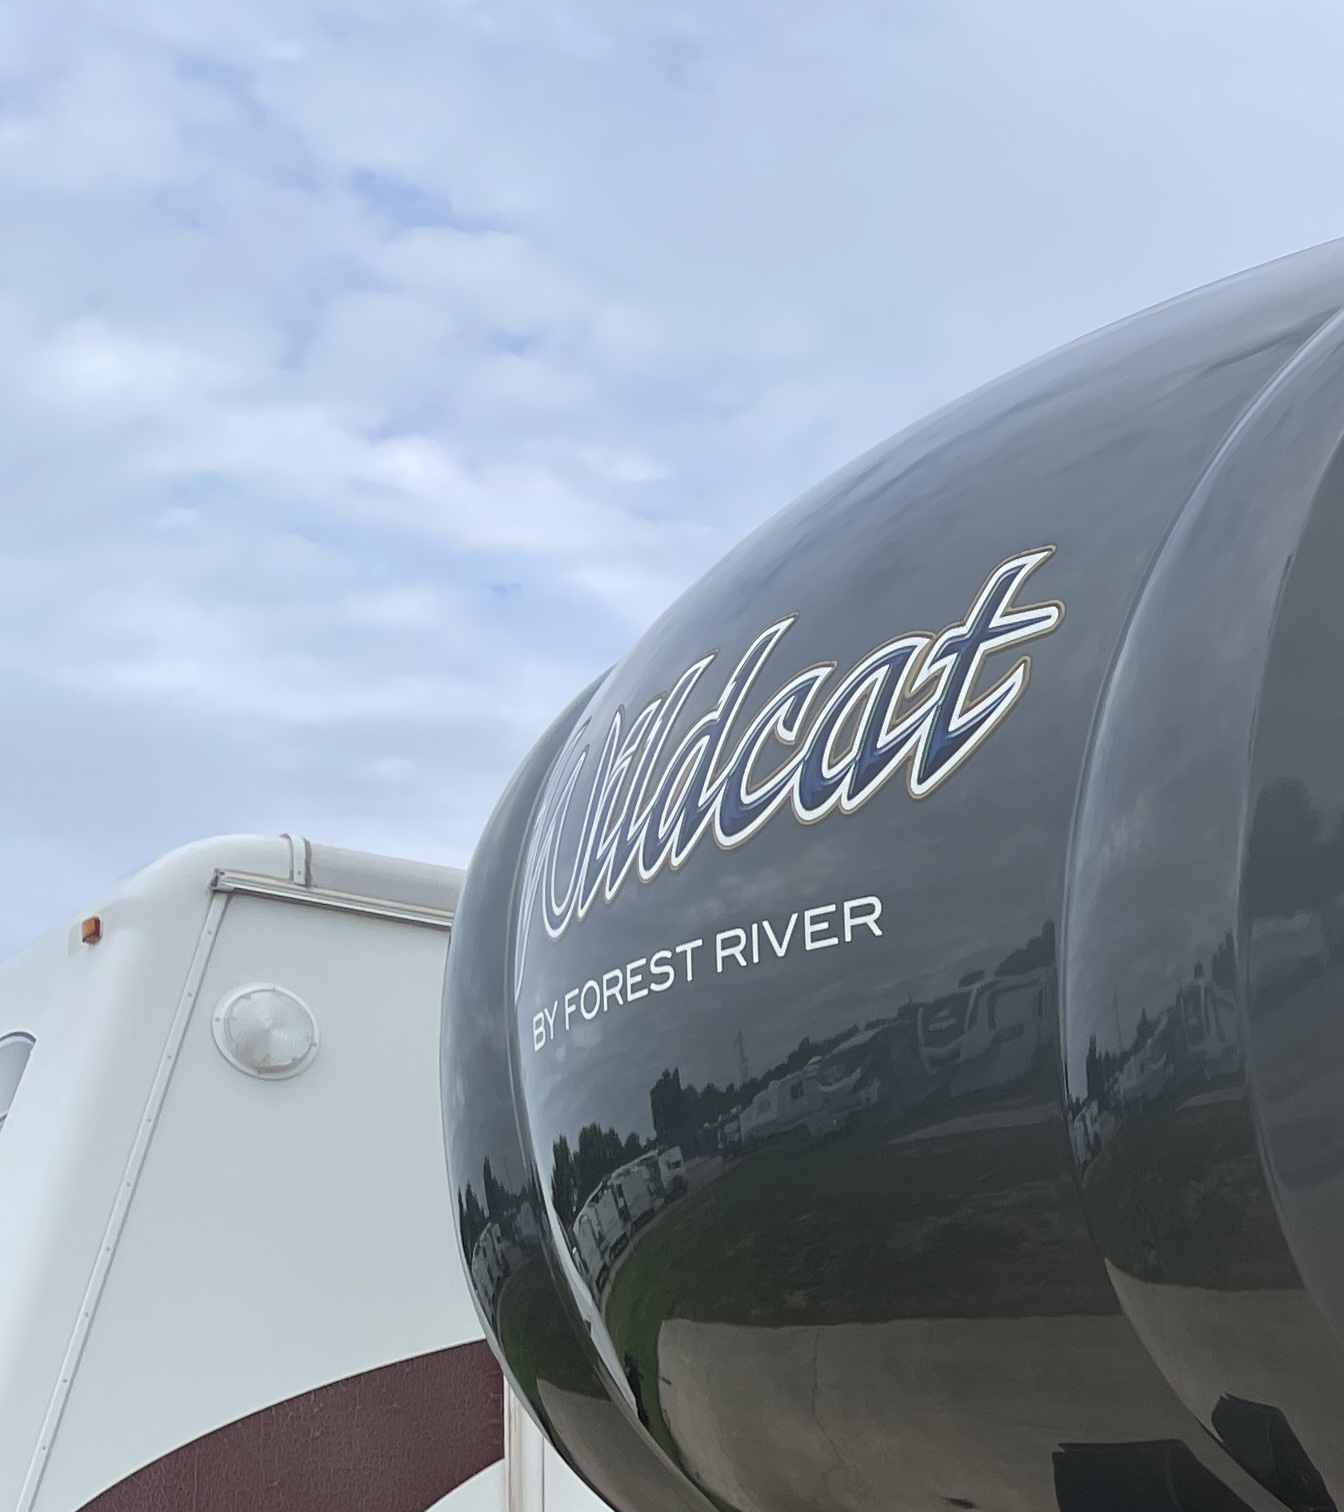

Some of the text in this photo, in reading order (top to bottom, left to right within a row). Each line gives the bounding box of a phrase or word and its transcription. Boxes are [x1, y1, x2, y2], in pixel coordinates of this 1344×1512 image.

[514, 545, 1067, 1004] Wildcat
[532, 895, 883, 1052] BY FOREST RIVER
